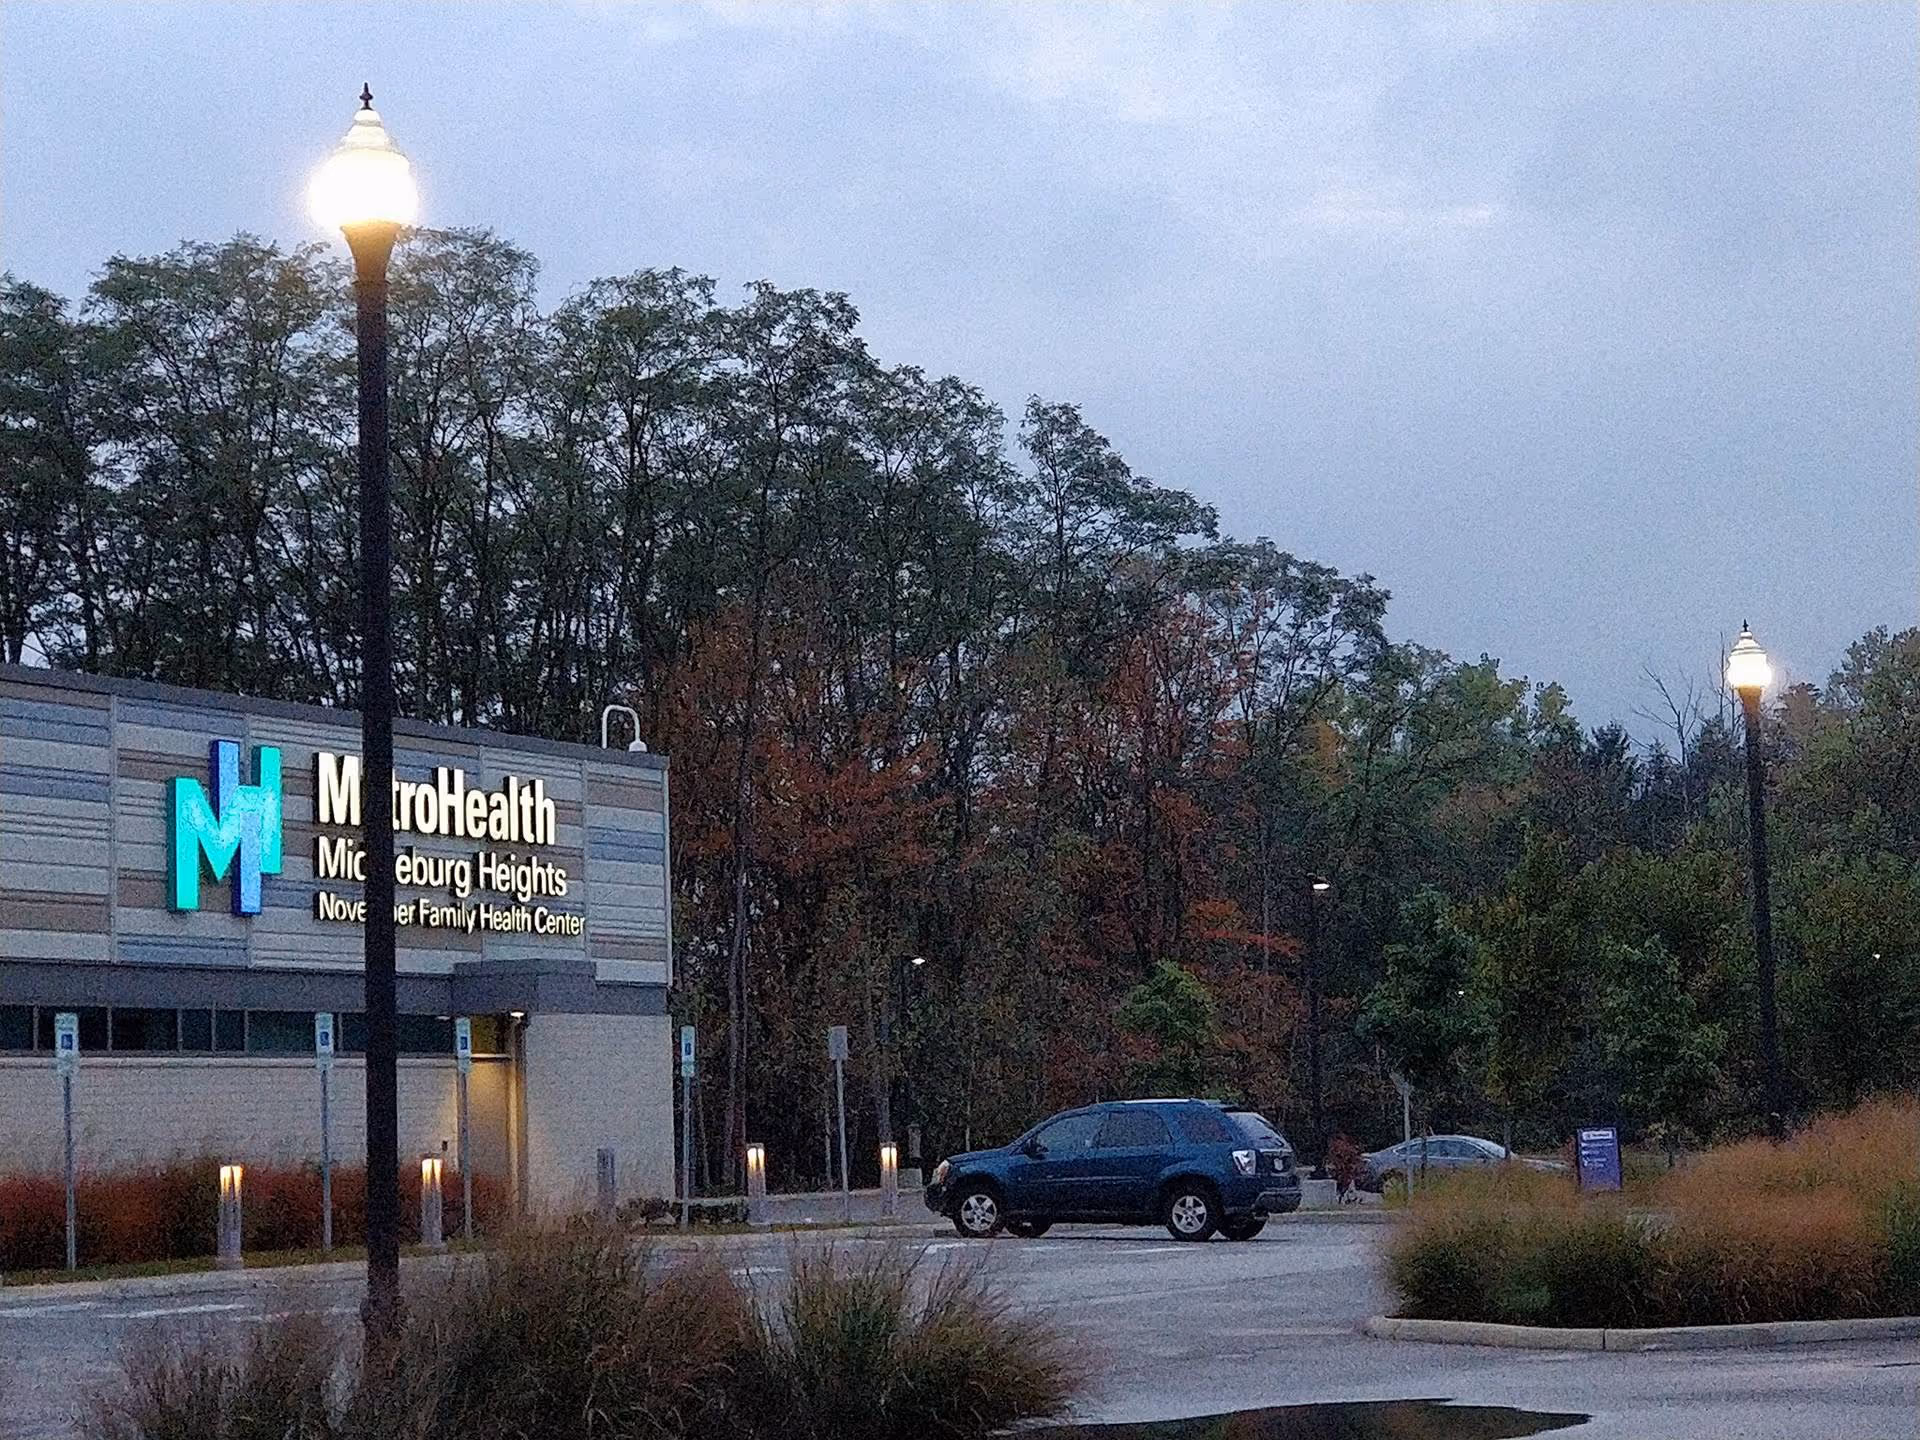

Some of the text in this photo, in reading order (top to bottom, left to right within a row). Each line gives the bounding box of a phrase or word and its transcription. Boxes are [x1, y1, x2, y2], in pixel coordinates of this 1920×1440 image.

[317, 751, 556, 846] MtroHealth
[317, 835, 567, 902] Mieburg Heights
[317, 890, 585, 935] Noveer Family Health Center
